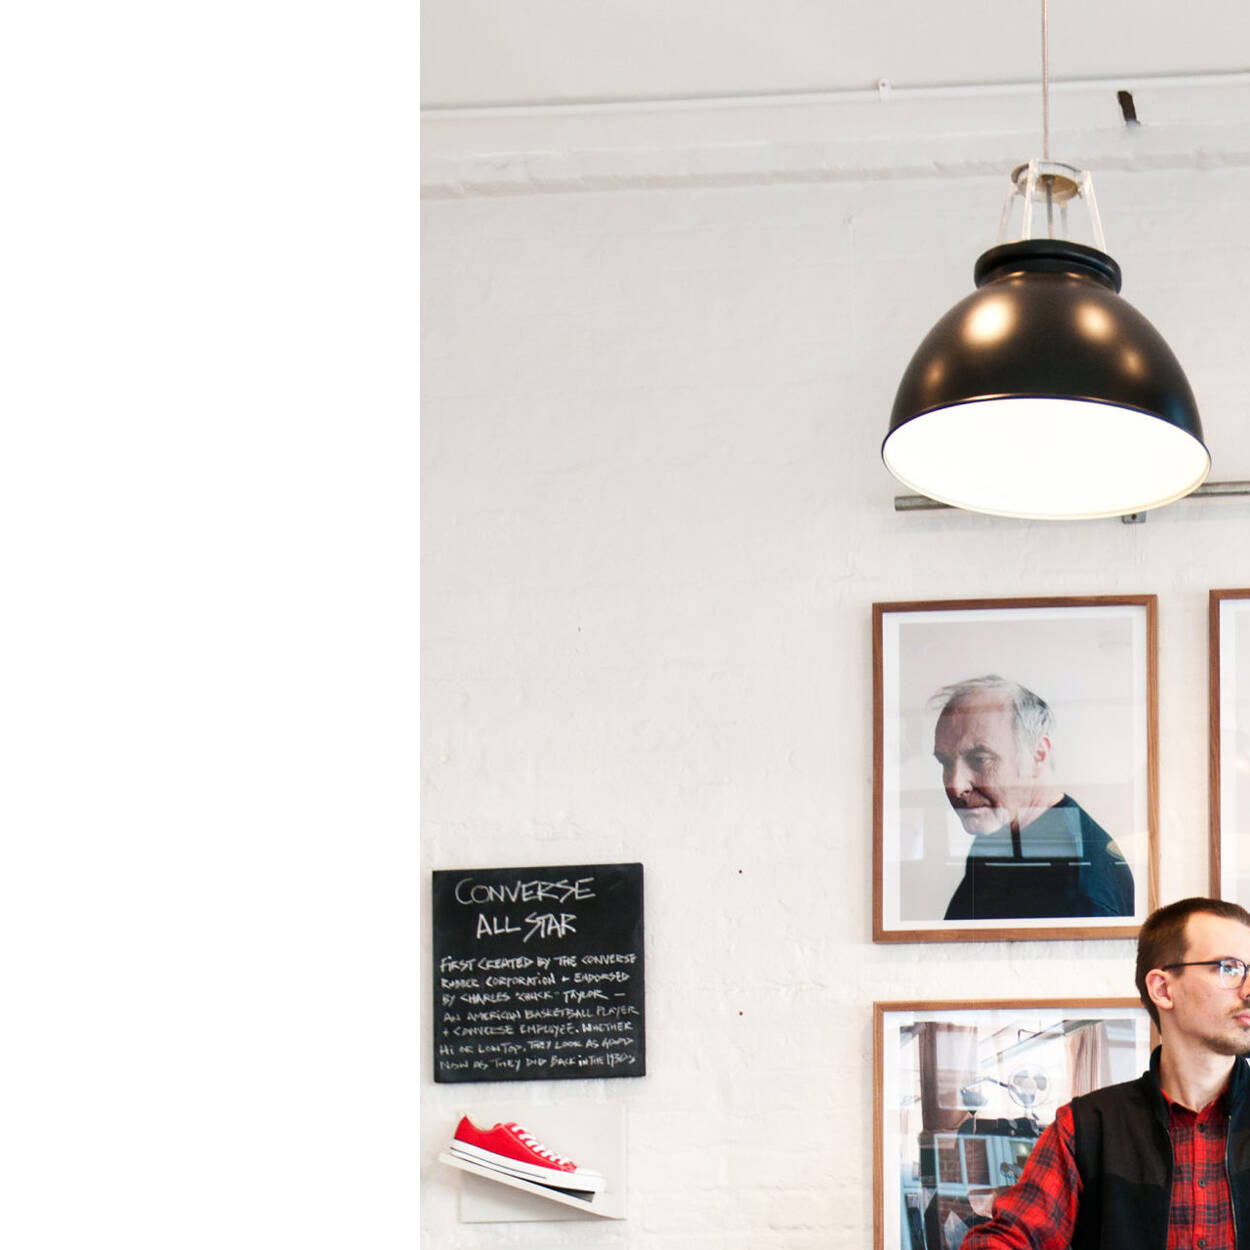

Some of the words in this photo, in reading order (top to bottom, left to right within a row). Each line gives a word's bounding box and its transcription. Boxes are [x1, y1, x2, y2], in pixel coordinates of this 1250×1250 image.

[455, 877, 596, 905] CONVERSE
[476, 914, 521, 939] ALL
[523, 912, 577, 943] STAR
